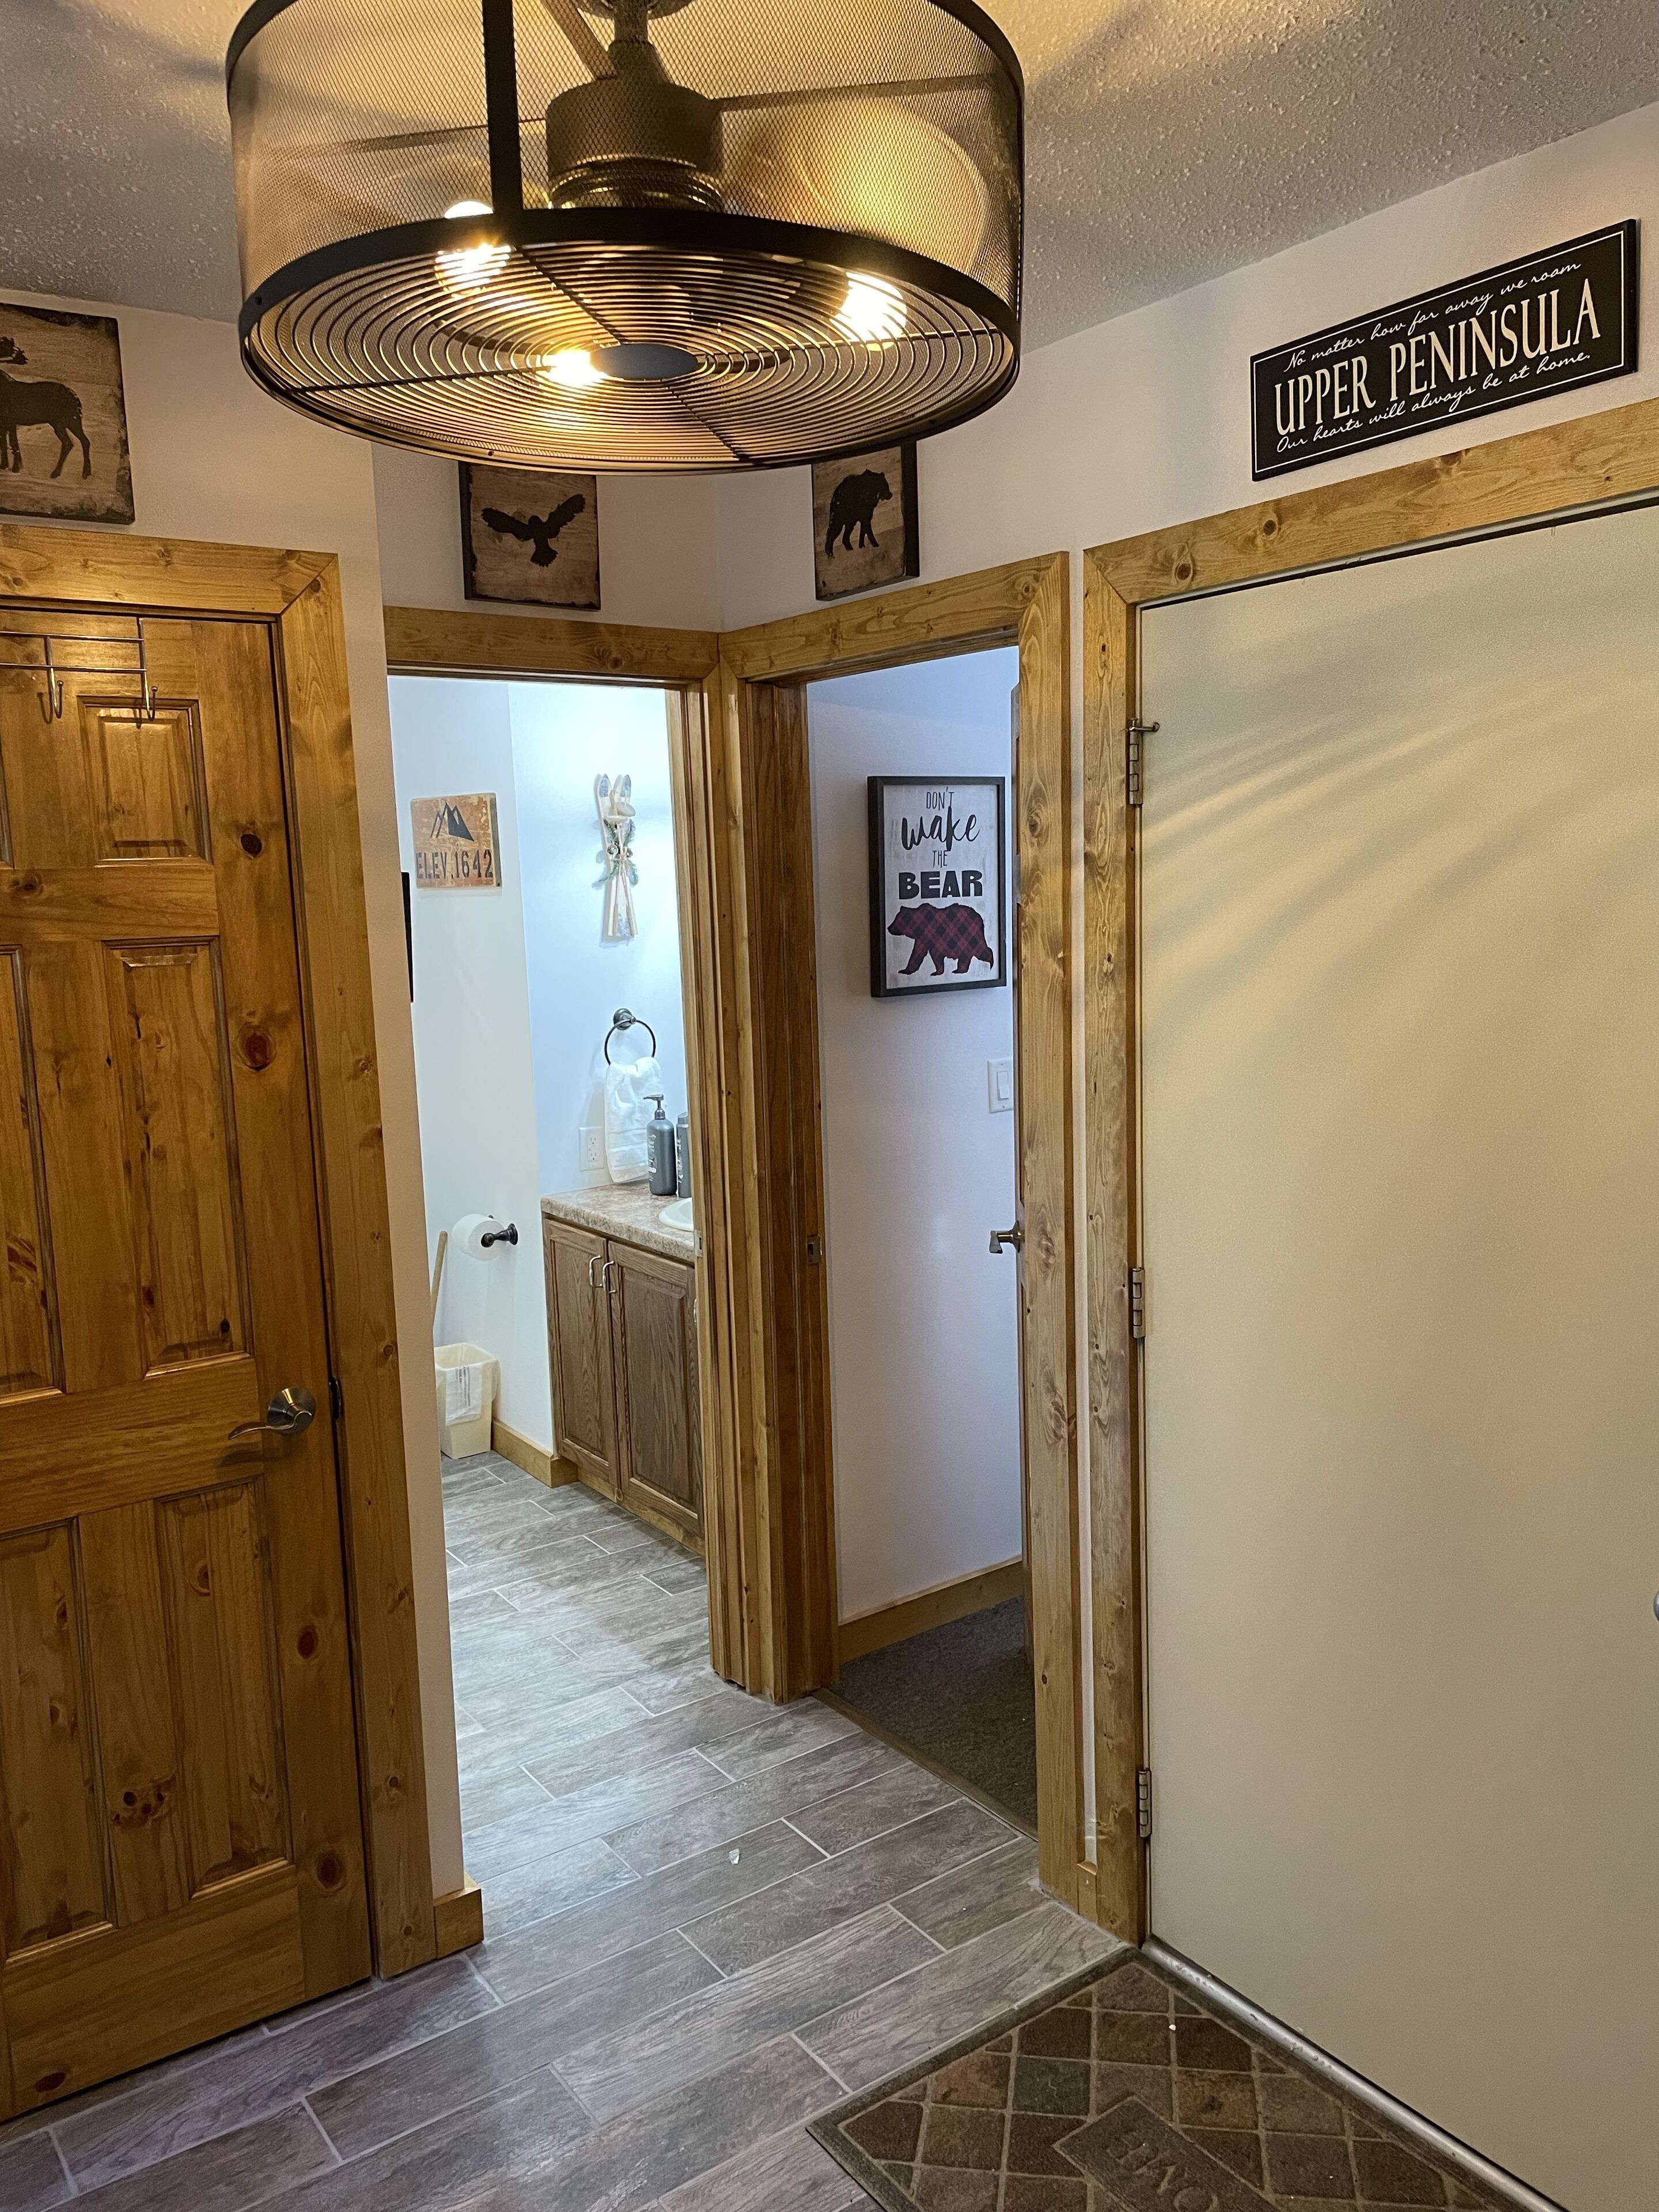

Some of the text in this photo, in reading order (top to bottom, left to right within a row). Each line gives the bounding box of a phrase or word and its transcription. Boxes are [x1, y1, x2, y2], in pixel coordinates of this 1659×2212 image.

[1283, 263, 1581, 373] No matter how far away we roam
[1274, 278, 1601, 435] UPPER PENINSULA
[1277, 351, 1590, 453] Our hearts will always be at home.
[926, 786, 955, 810] DON'T
[901, 806, 980, 852] wake
[932, 850, 948, 868] THE
[898, 869, 983, 900] BEAR
